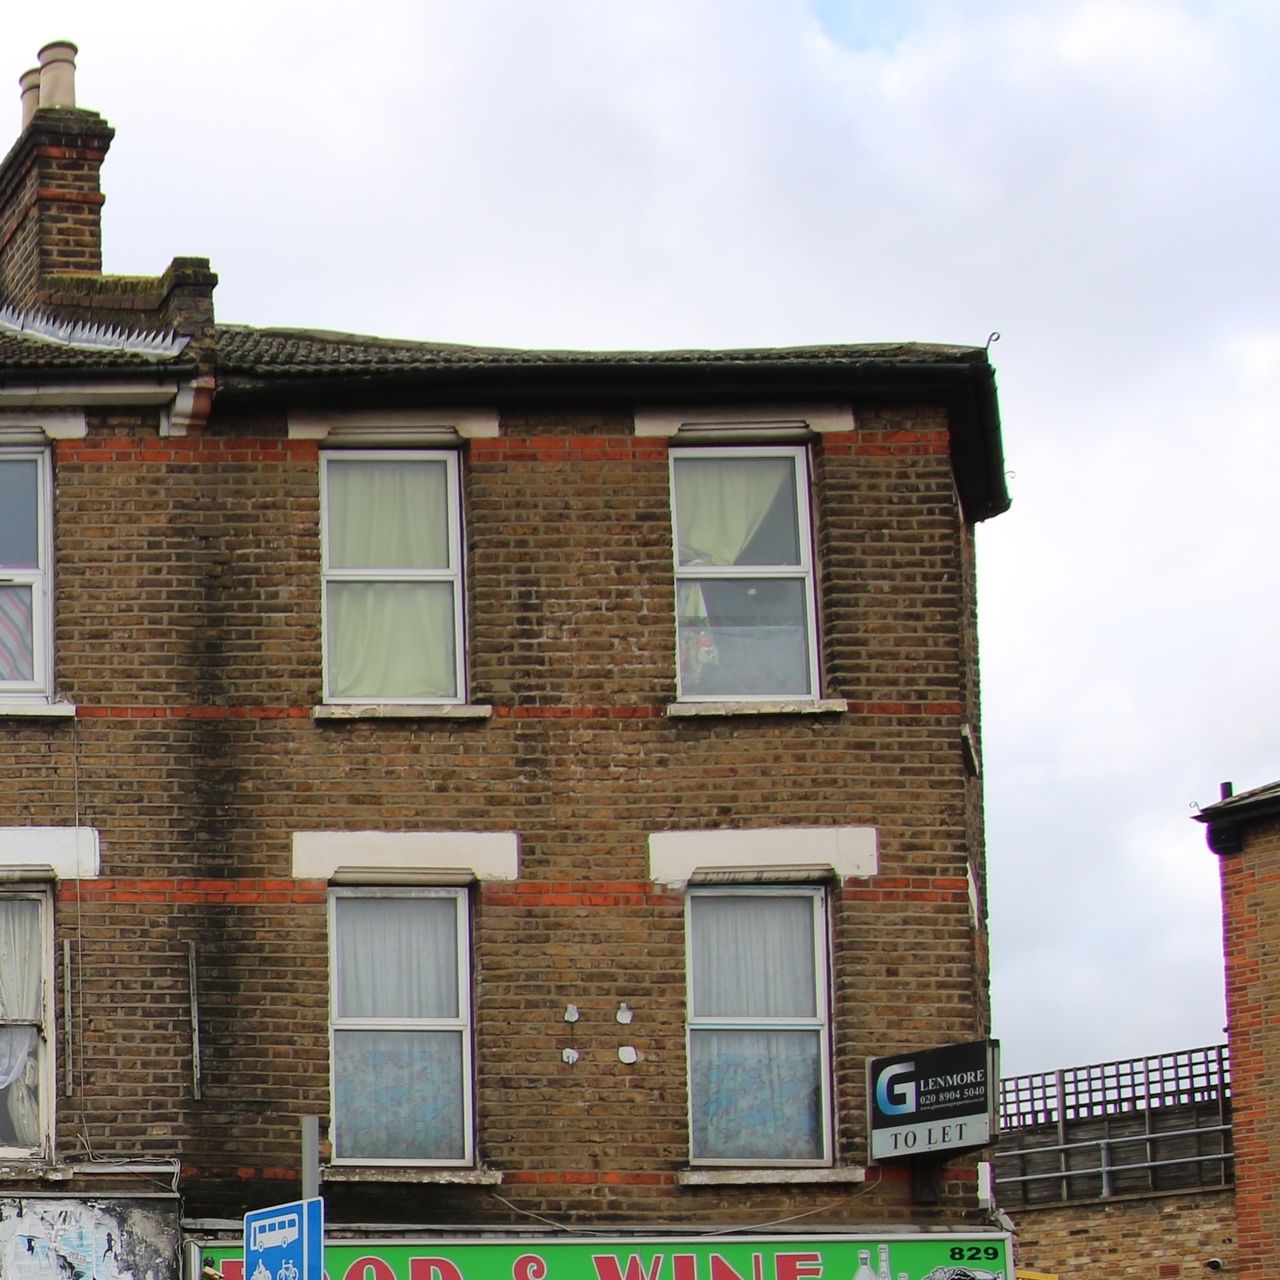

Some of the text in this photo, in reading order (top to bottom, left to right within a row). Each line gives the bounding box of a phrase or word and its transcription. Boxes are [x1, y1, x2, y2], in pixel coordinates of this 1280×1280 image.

[920, 1094, 936, 1105] 020
[939, 1091, 960, 1102] 8904
[963, 1086, 985, 1098] 5040
[890, 1123, 966, 1150] TO LET
[949, 1246, 999, 1261] 829
